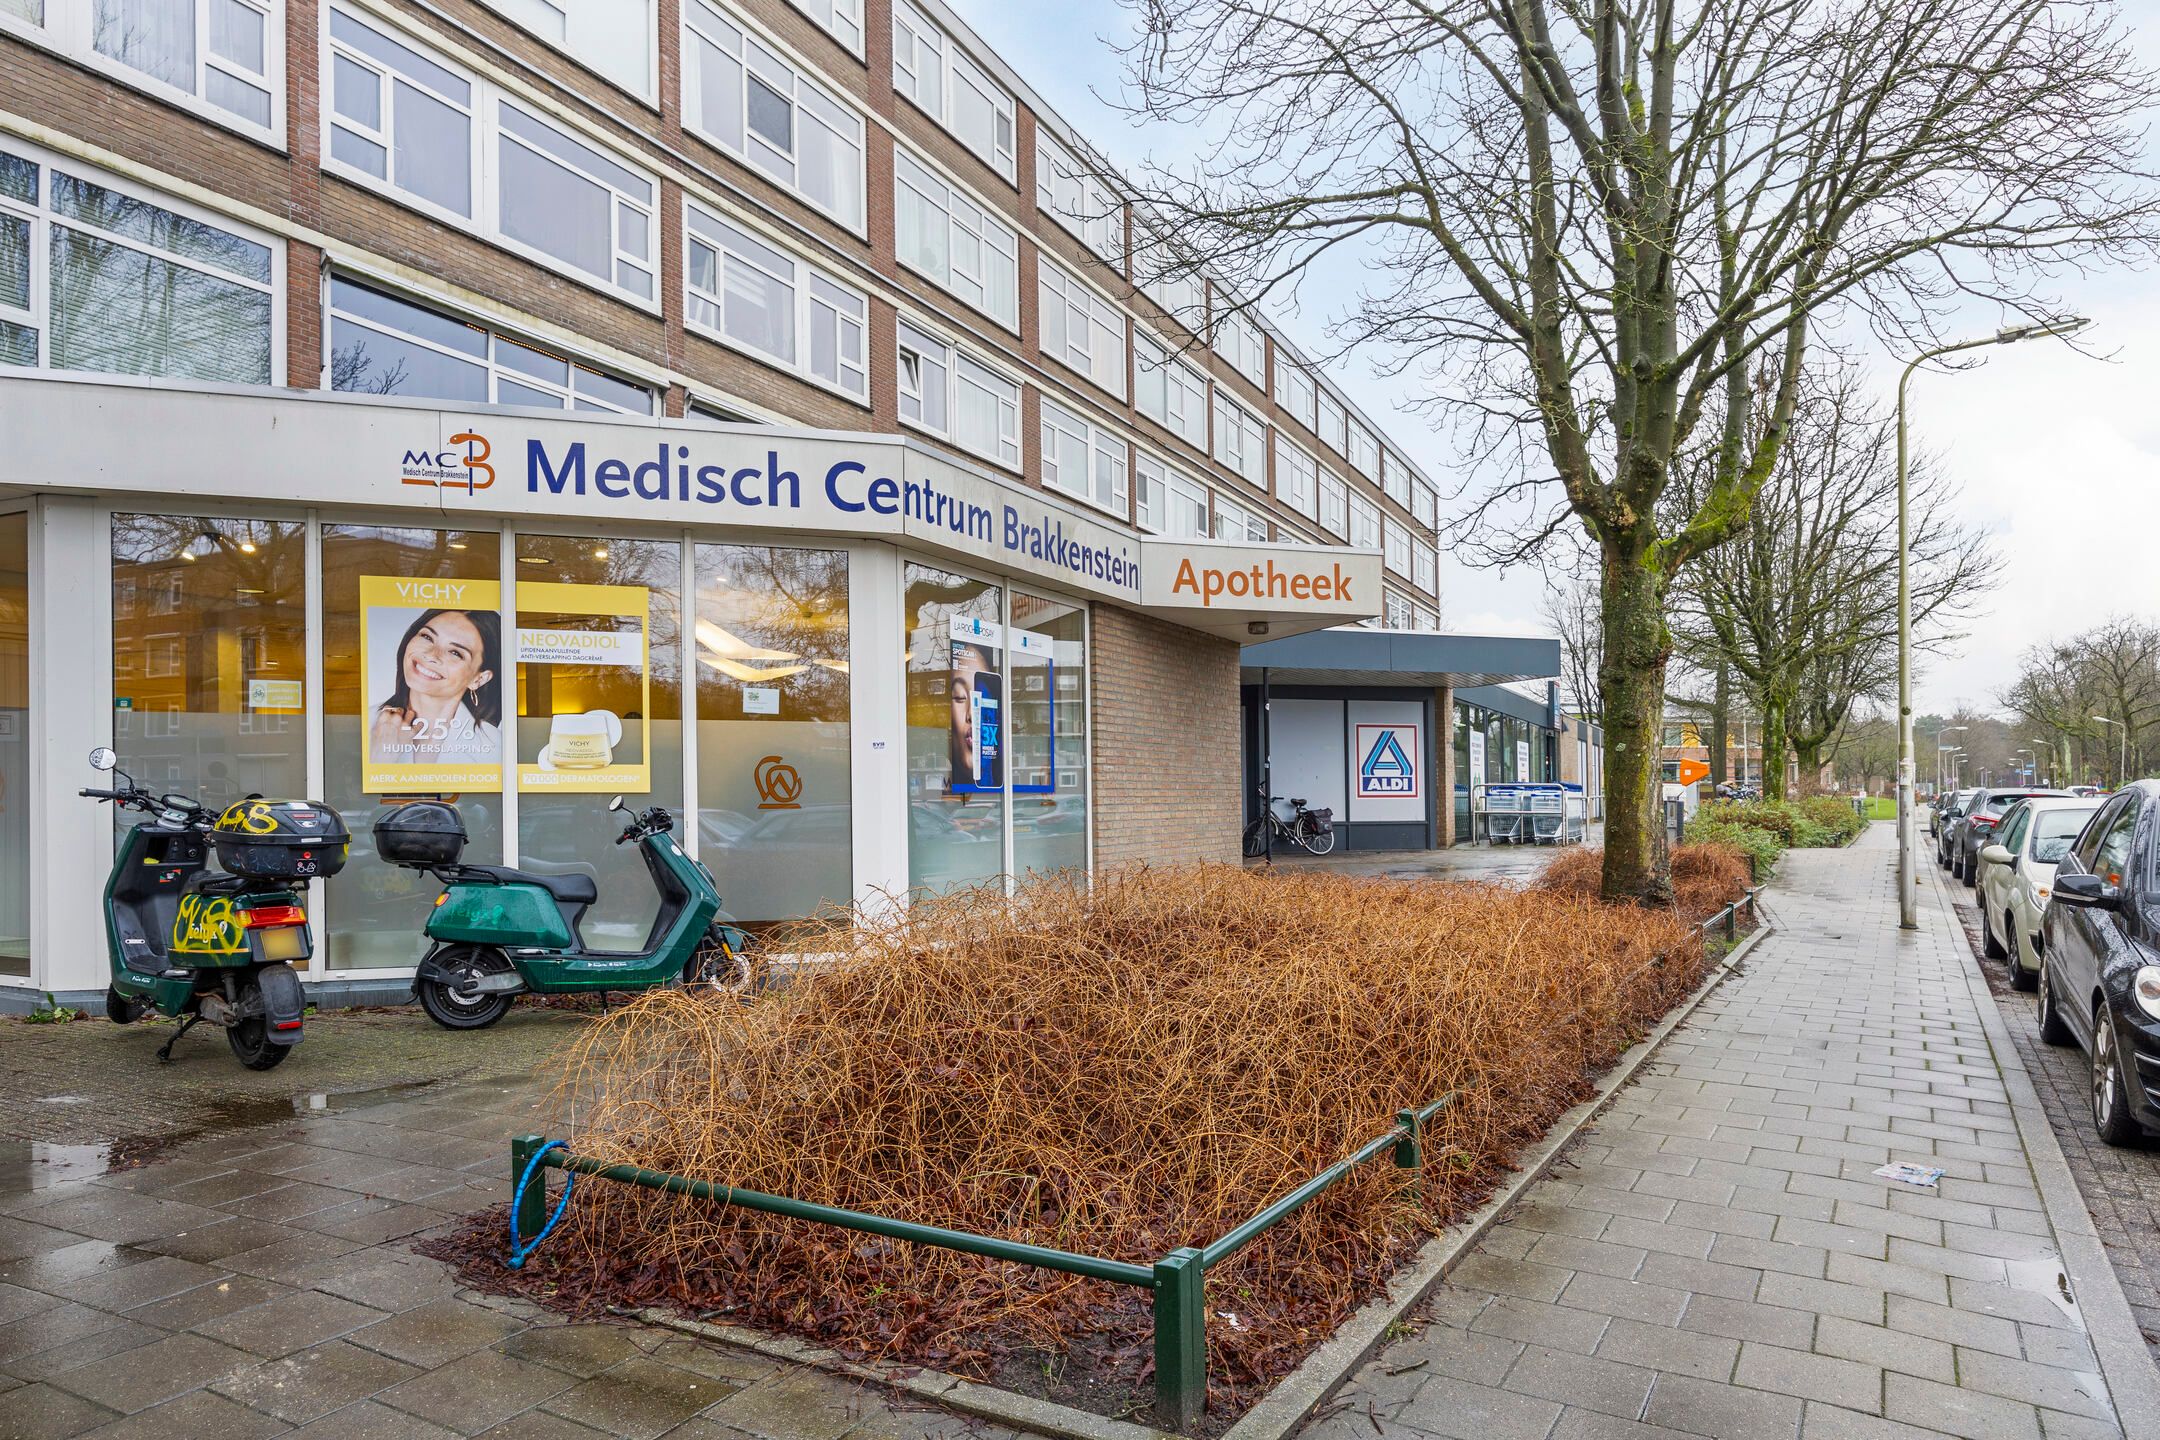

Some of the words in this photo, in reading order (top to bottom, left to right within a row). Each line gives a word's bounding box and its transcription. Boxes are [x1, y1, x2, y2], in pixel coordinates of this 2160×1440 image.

[403, 467, 421, 476] Medisch
[422, 468, 440, 477] Centrum
[527, 439, 800, 508] Medisch
[824, 460, 993, 543] Centrum
[1003, 504, 1139, 591] Brakkenstein
[396, 582, 467, 600] VICHY
[1172, 558, 1353, 607] Apotheek
[521, 633, 621, 649] NEOVADIOL
[520, 647, 581, 655] LIPIDENAANVULLENDE
[401, 717, 475, 741] -25%
[982, 726, 998, 746] 3X
[370, 773, 398, 783] MERK
[399, 773, 466, 783] AANBEVOLEN
[469, 774, 498, 783] DOOR
[1367, 777, 1409, 791] ALDI
